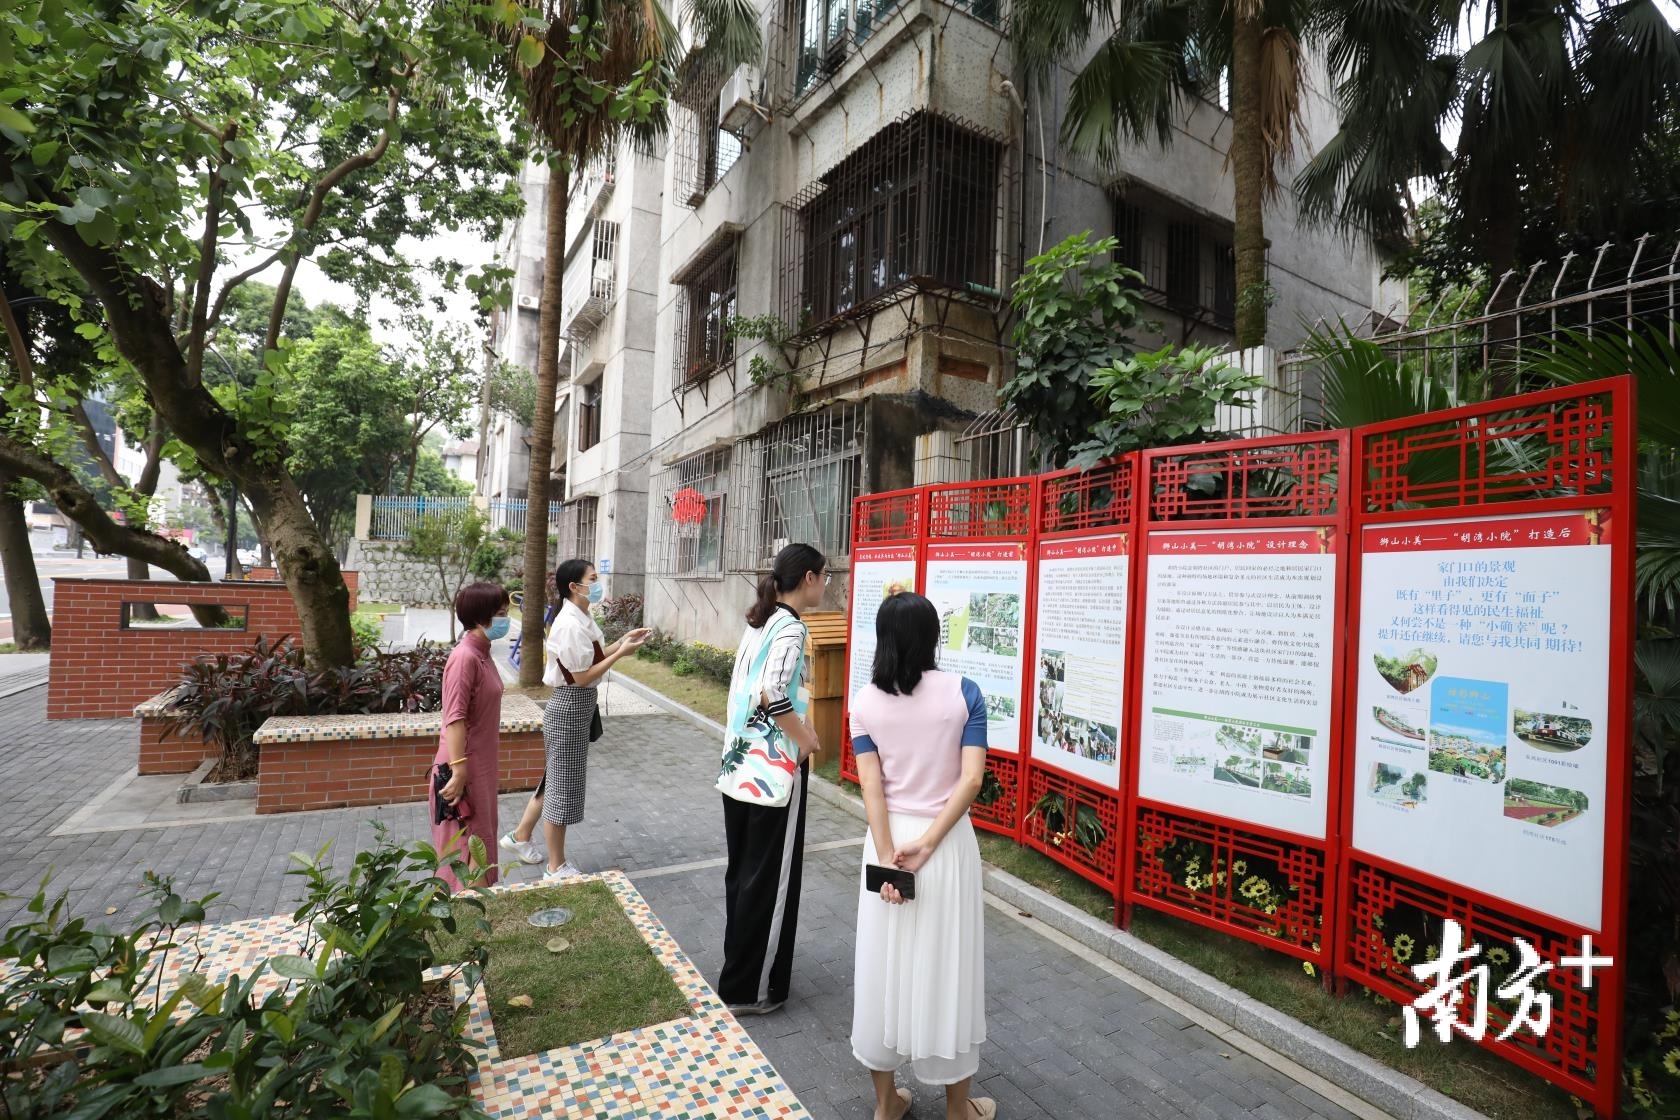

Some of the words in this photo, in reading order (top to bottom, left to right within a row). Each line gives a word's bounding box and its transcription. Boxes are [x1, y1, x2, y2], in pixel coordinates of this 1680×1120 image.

[1437, 560, 1516, 573] 家门口的景观
[1443, 575, 1508, 588] 由我们决定
[1413, 603, 1545, 619] 这样看得见的民生福祉
